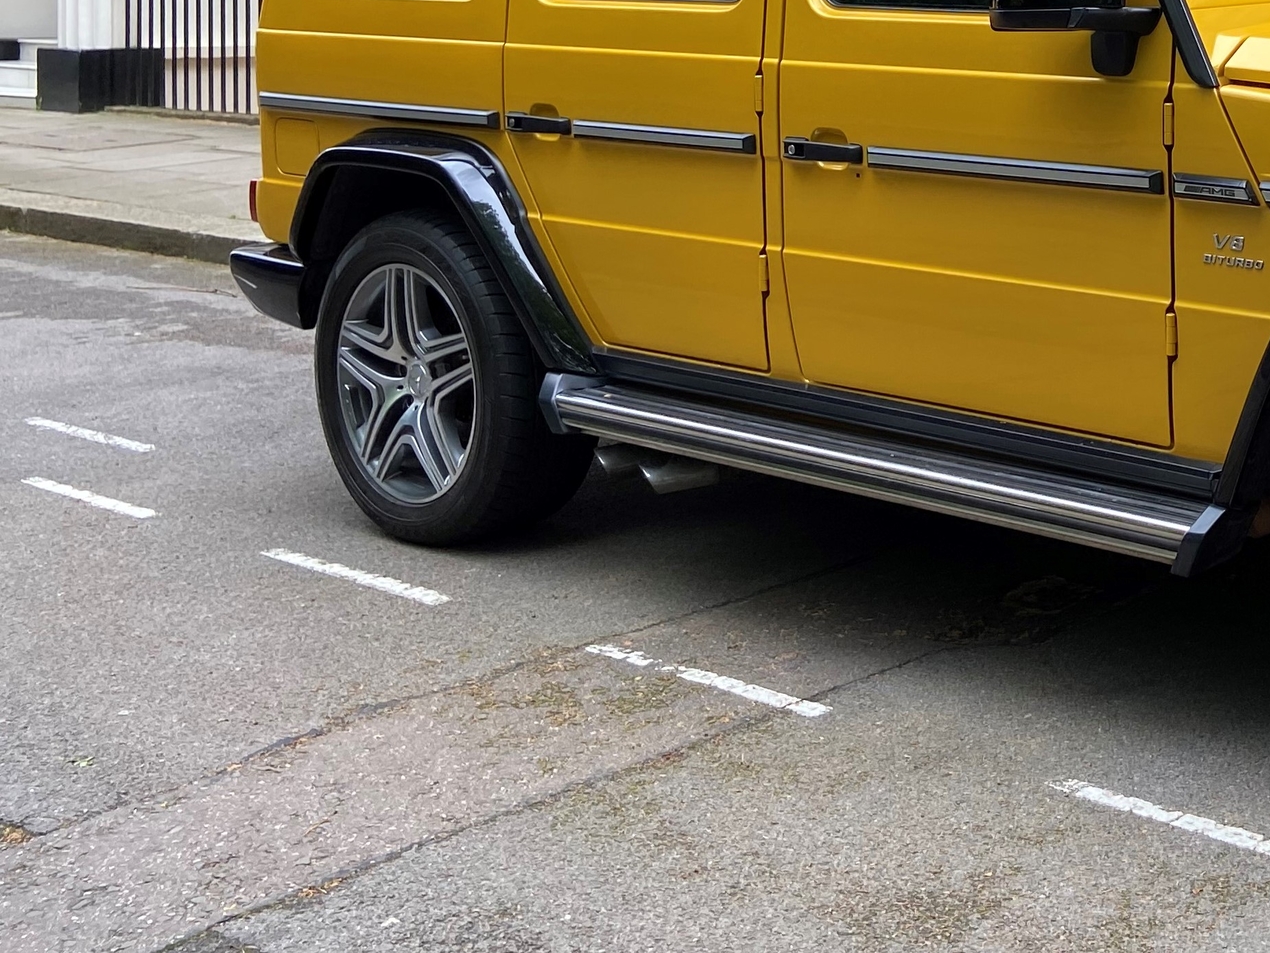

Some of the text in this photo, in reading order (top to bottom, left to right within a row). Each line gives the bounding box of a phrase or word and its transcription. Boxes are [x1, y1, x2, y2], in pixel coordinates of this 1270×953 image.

[1200, 186, 1236, 197] AMG
[1213, 233, 1245, 251] V8
[1203, 253, 1265, 270] BITURBO
